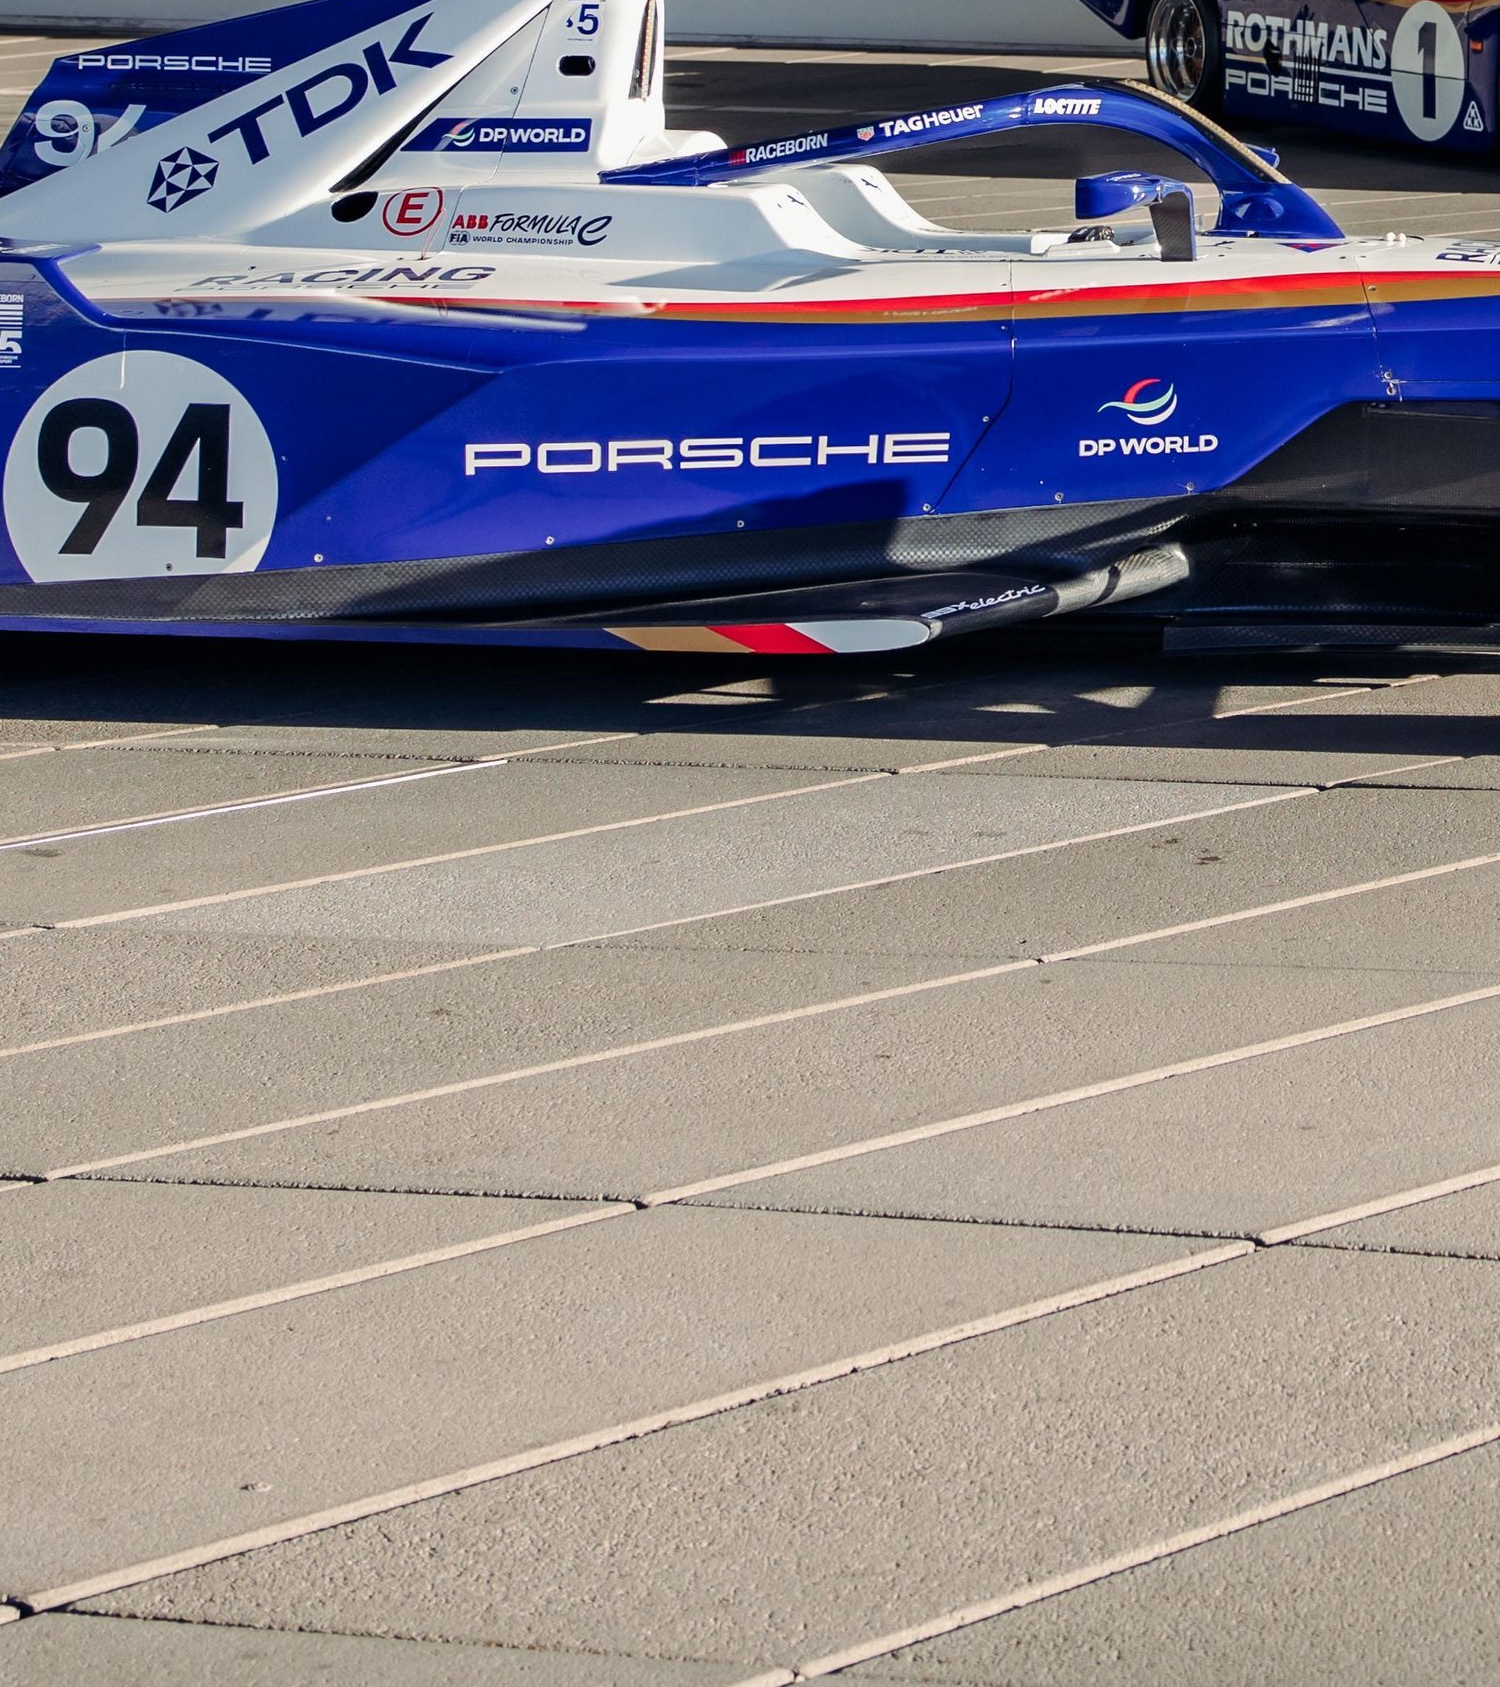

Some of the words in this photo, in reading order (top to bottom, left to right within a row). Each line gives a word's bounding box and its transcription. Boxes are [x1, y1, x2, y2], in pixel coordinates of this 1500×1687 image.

[1226, 10, 1388, 70] ROTHMANS
[78, 54, 272, 72] PORSCHE
[1418, 21, 1437, 120] 1
[207, 11, 455, 165] TDK
[1226, 68, 1388, 114] PORSCHE
[1033, 97, 1102, 116] LOCTITE
[479, 128, 507, 143] DP
[509, 128, 587, 143] WORLD
[745, 133, 829, 165] RACEBORN
[452, 215, 489, 230] ABB
[489, 213, 583, 236] FORMULA
[506, 236, 574, 246] CHAMPIONSHIP
[189, 266, 498, 287] RACING
[464, 432, 951, 476] PORSCHE
[1078, 440, 1116, 456] DP
[1118, 435, 1219, 455] WORLD
[36, 396, 245, 560] 94
